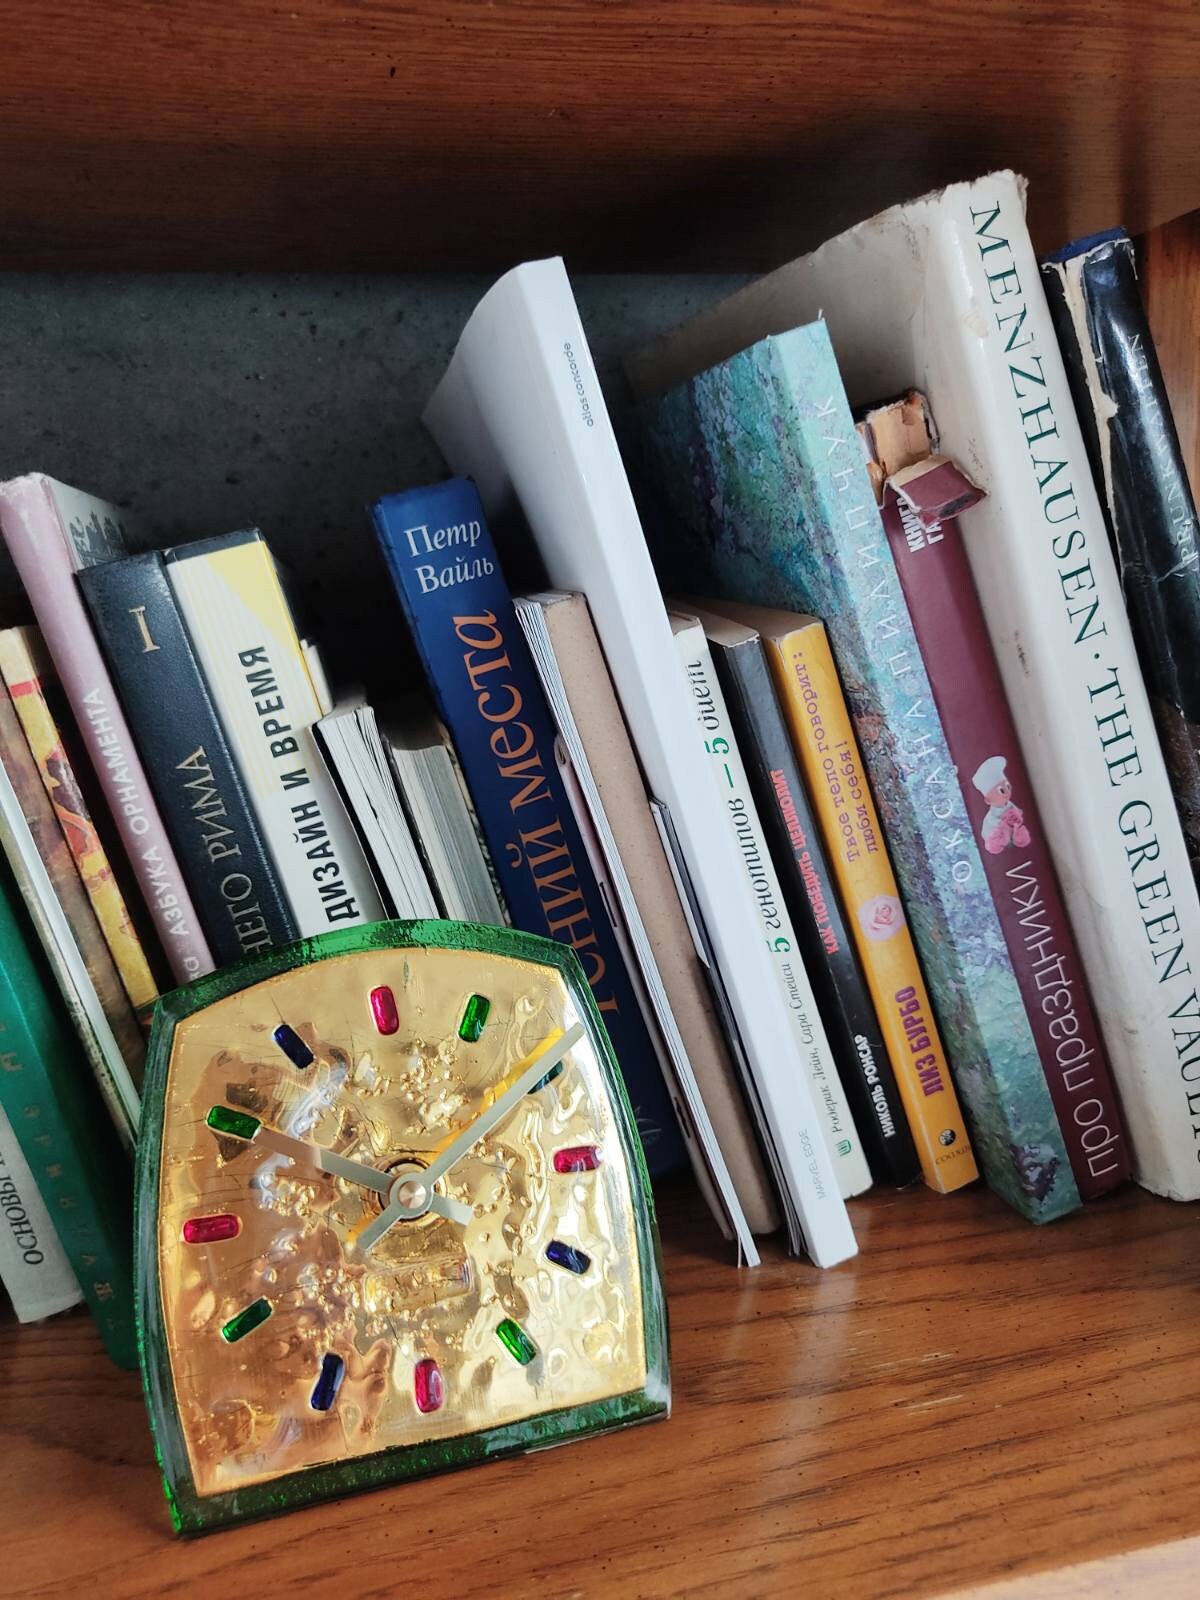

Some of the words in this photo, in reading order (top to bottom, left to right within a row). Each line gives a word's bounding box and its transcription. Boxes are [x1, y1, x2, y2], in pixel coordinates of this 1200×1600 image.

[563, 342, 585, 396] concorde
[580, 397, 594, 427] atlas
[404, 519, 481, 558] Петр
[415, 556, 494, 594] Вайль
[968, 200, 1108, 645] MENZHAUSEN
[1087, 667, 1143, 787] THE
[1118, 800, 1192, 984] GREEN
[238, 646, 300, 759] ВРЕМЯ
[687, 659, 720, 731] диет
[82, 687, 149, 836] ОРНАМЕНТА
[704, 737, 730, 755] 5
[175, 745, 242, 864] РИМА
[279, 767, 311, 791] И
[823, 757, 846, 809] тело
[904, 700, 973, 883] ОКСАНА
[770, 769, 807, 850] ЦЕЛЛЮЛИТ
[856, 803, 879, 853] люби
[290, 799, 361, 923] ДИЗАЙН
[728, 797, 782, 930] генотипов
[838, 813, 861, 863] Твое
[137, 844, 190, 937] АЗБУКА
[799, 851, 831, 927] ПОБЕДИТЬ
[766, 936, 791, 954] 5
[818, 926, 840, 954] КАК
[894, 985, 932, 1053] БУРБО
[853, 1033, 882, 1085] РОНСАР
[914, 1053, 945, 1097] ЛИЗ
[868, 1082, 897, 1139] НИКОЛЬ
